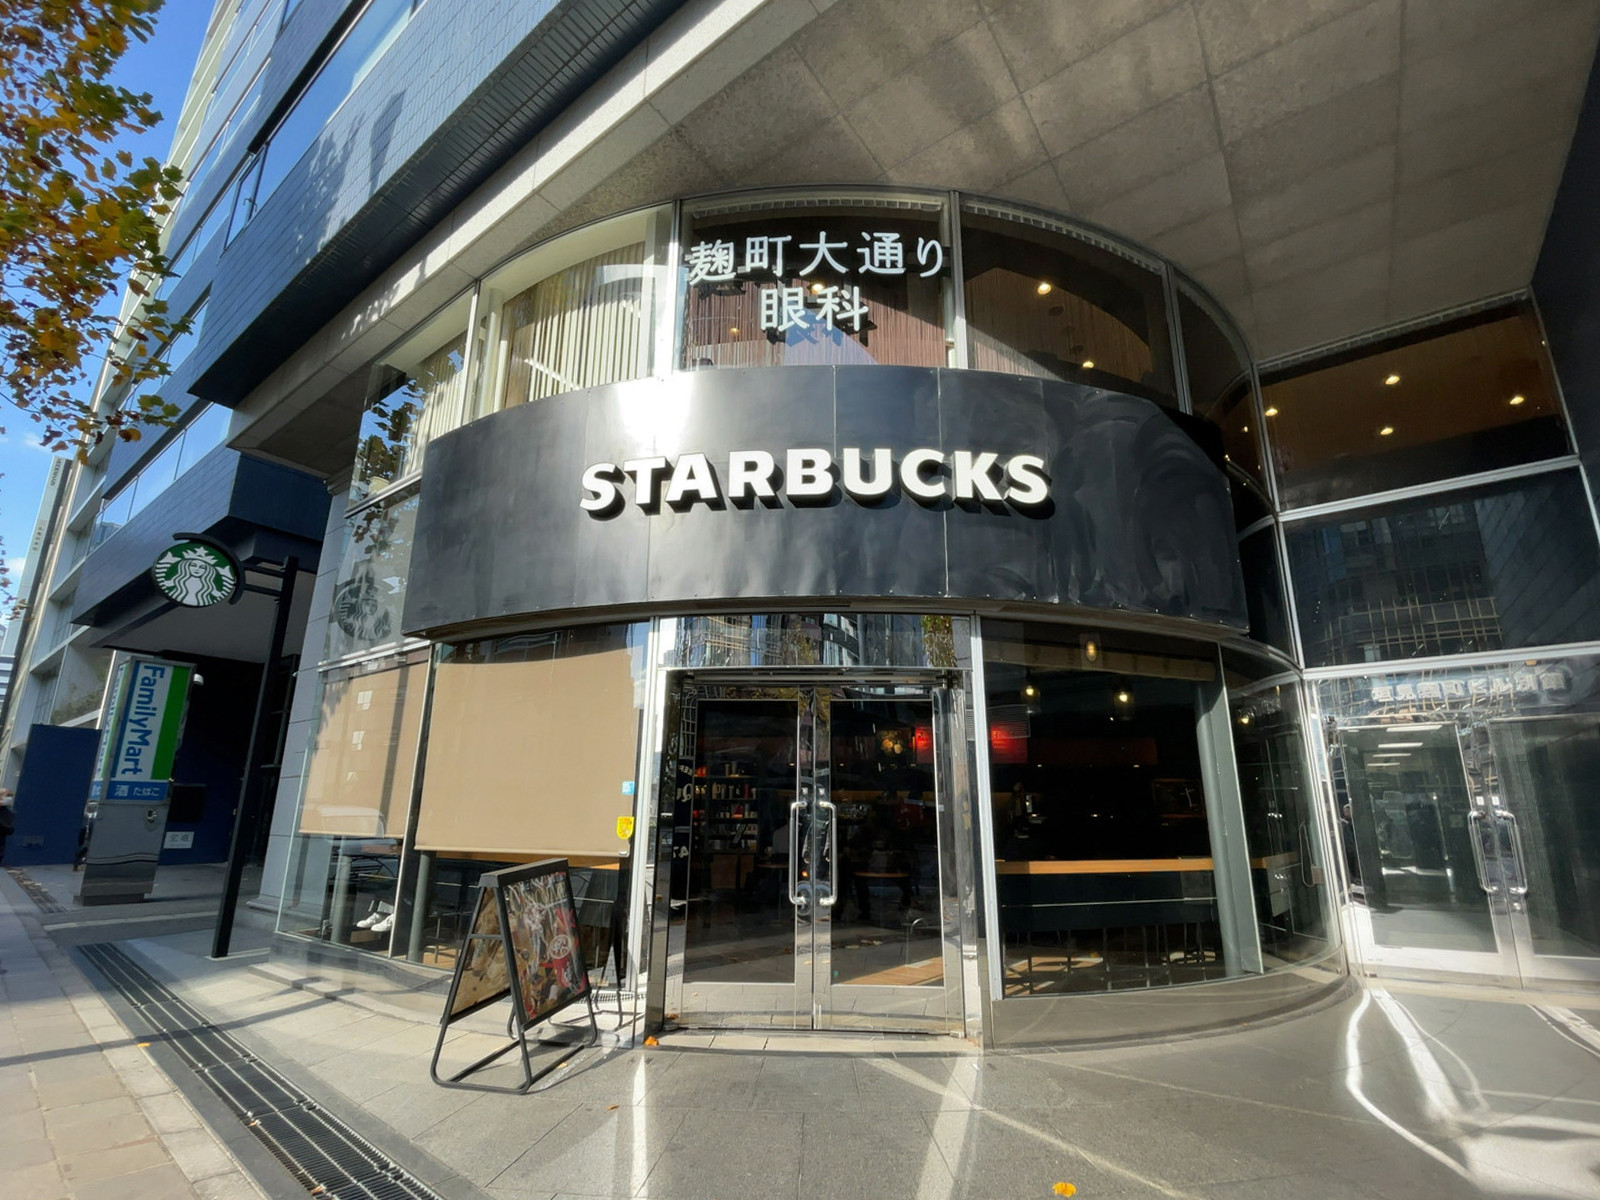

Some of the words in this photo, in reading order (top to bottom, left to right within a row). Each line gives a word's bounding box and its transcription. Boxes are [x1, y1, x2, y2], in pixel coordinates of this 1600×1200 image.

[688, 230, 944, 286] 麹町大通り
[760, 285, 869, 333] 眼科
[579, 447, 1053, 515] STARBUCKS
[121, 665, 166, 776] FamilyMart
